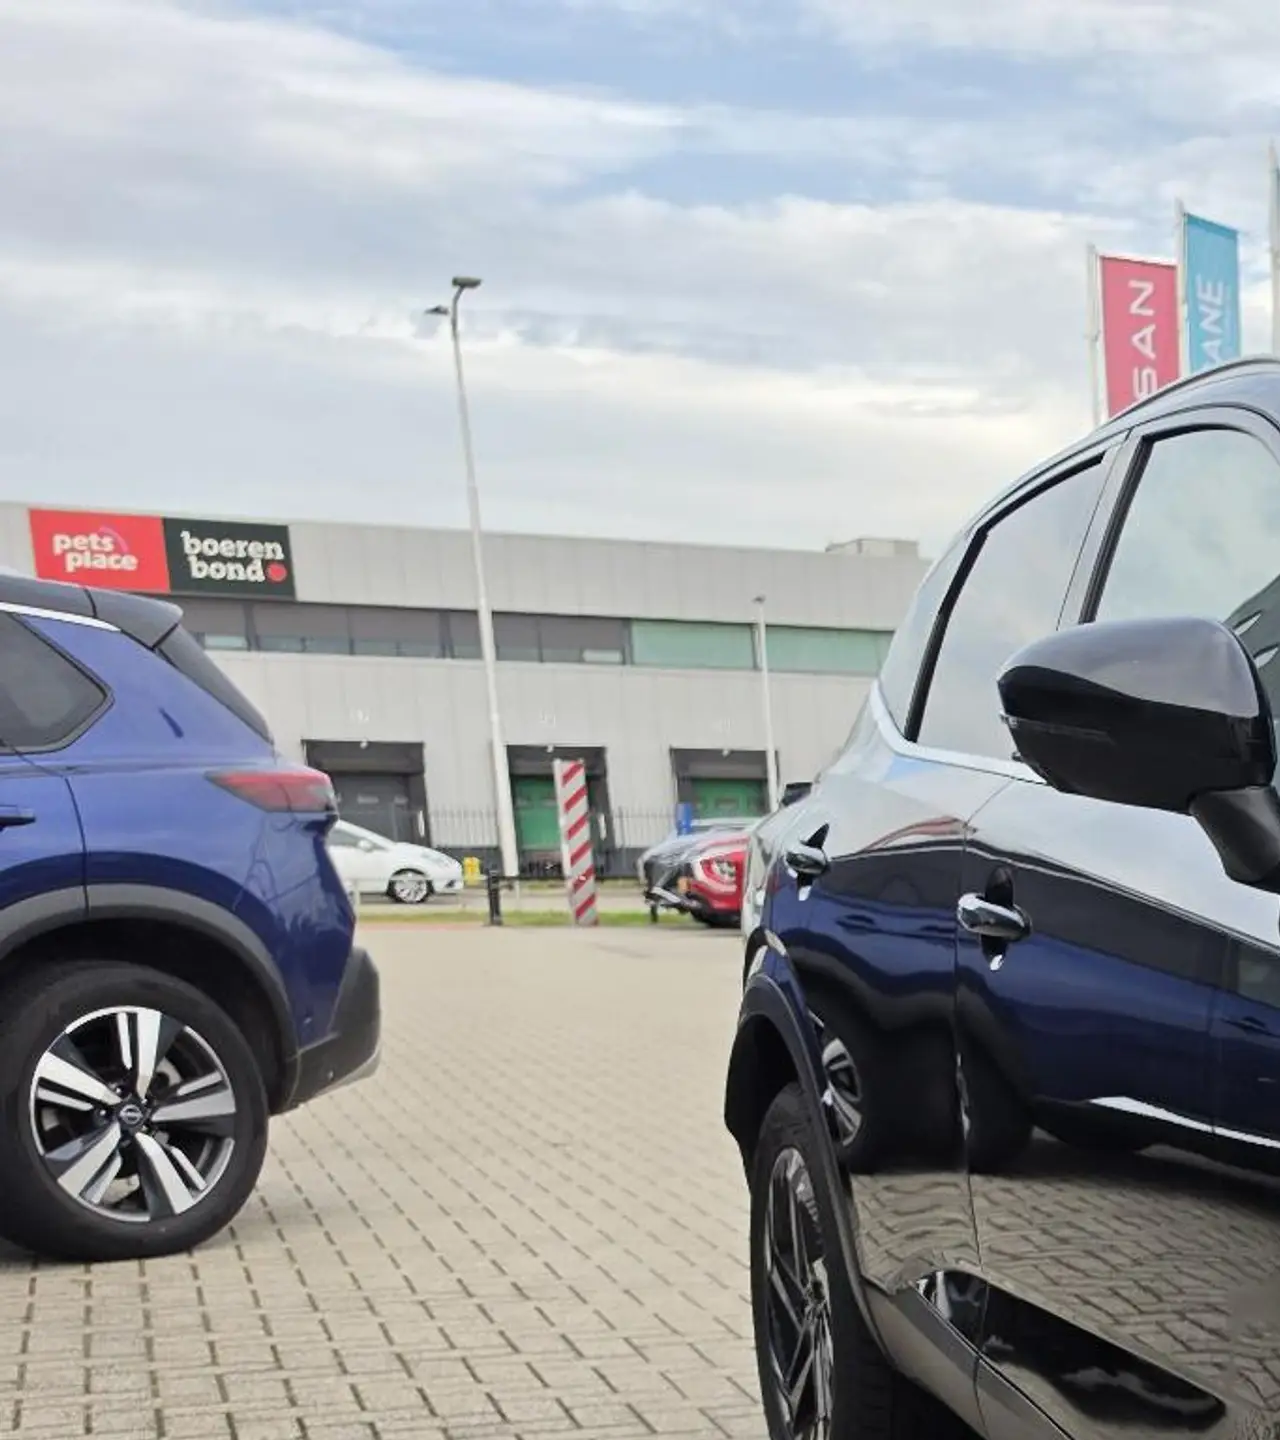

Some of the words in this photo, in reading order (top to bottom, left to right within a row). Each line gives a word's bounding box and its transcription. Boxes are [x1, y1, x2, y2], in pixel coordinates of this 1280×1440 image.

[52, 532, 115, 556] pets
[180, 529, 284, 560] boeren
[65, 550, 139, 573] place
[187, 554, 266, 583] bond
